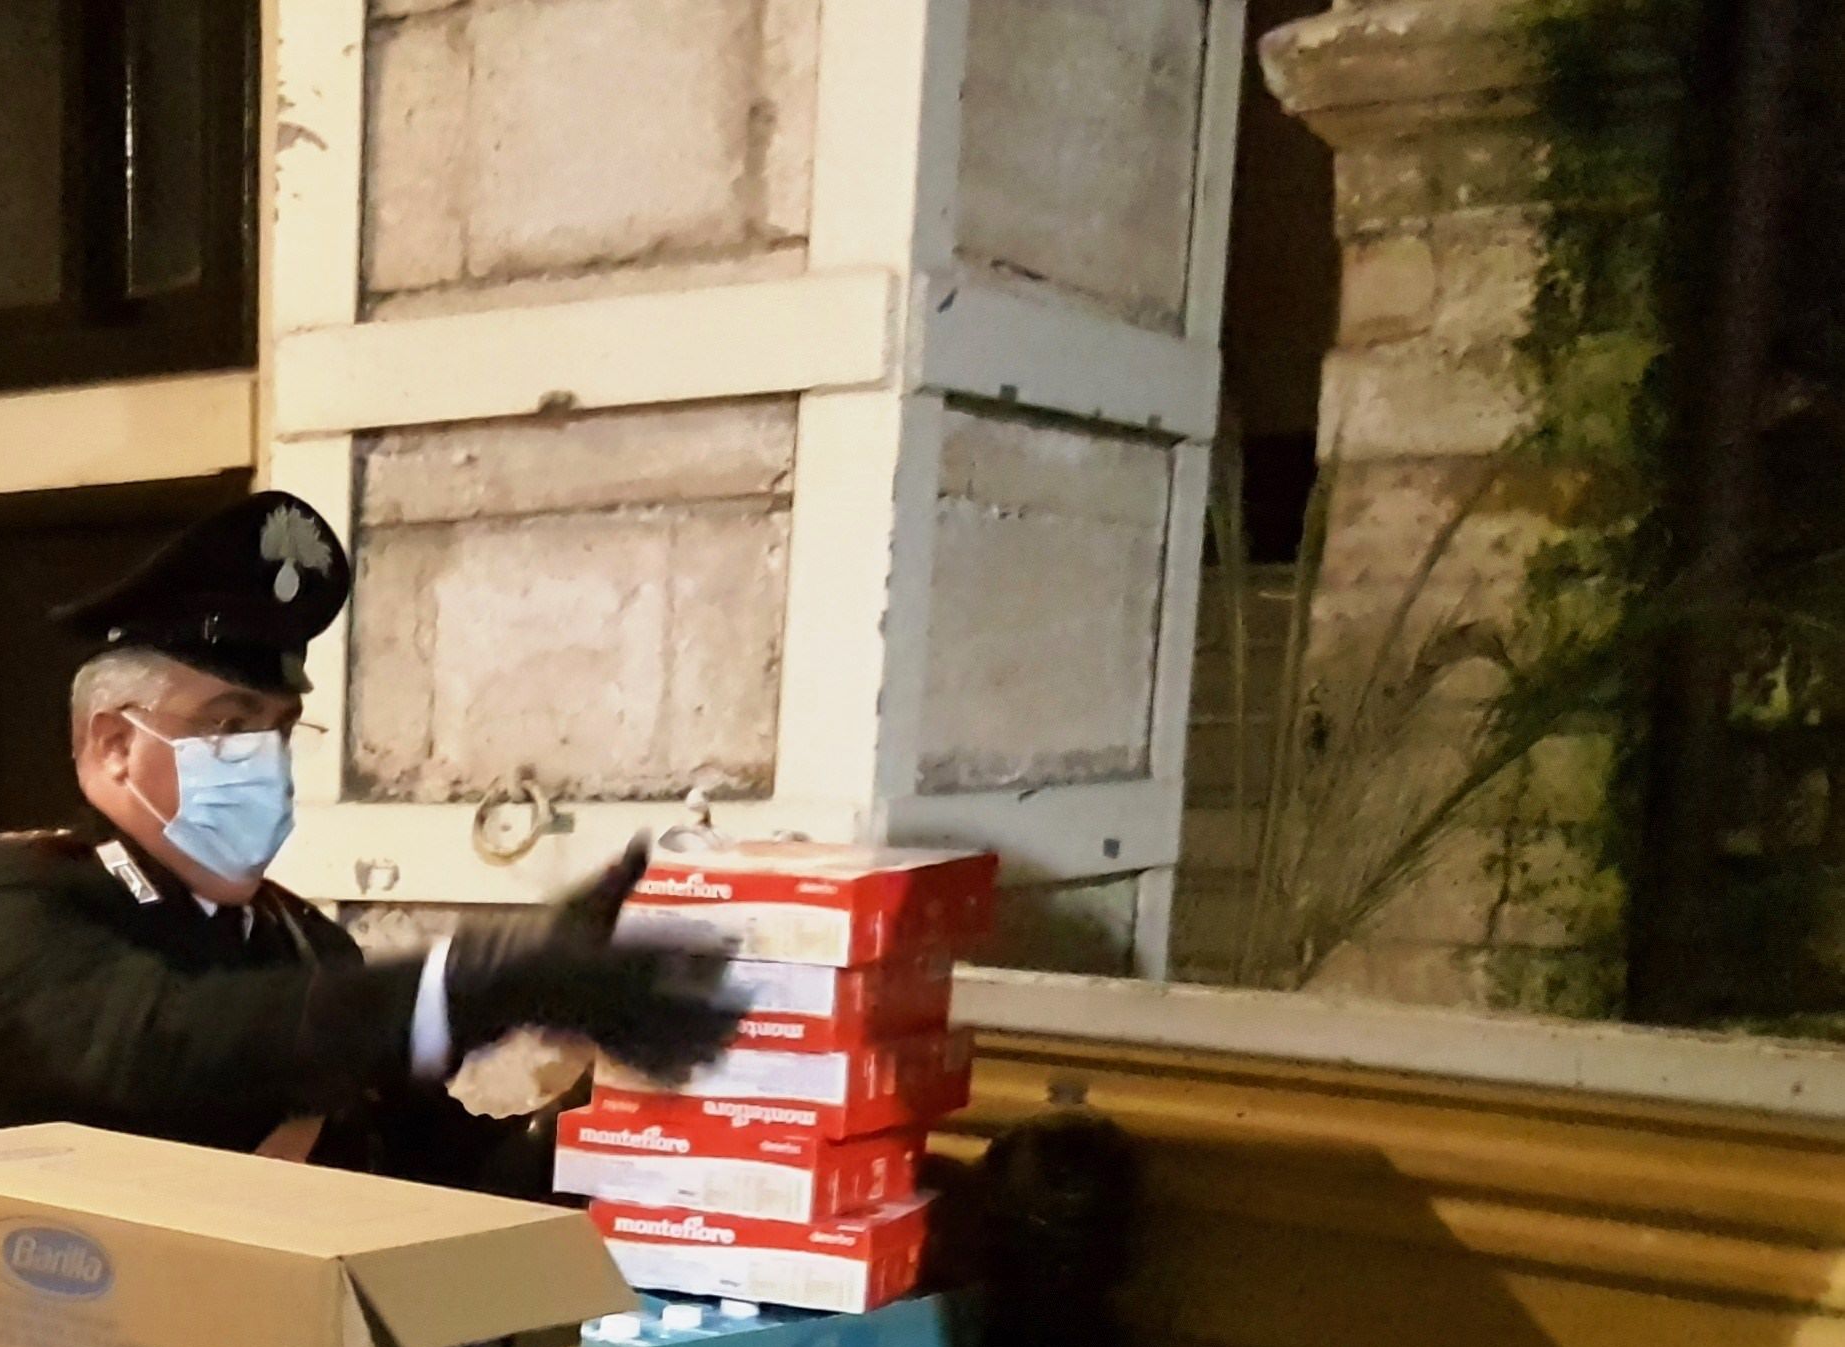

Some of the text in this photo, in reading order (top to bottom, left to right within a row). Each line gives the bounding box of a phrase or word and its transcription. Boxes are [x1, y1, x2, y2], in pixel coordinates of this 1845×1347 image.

[579, 1125, 691, 1154] montefiore
[614, 1215, 736, 1245] montefiore
[12, 1233, 103, 1283] Barilla
